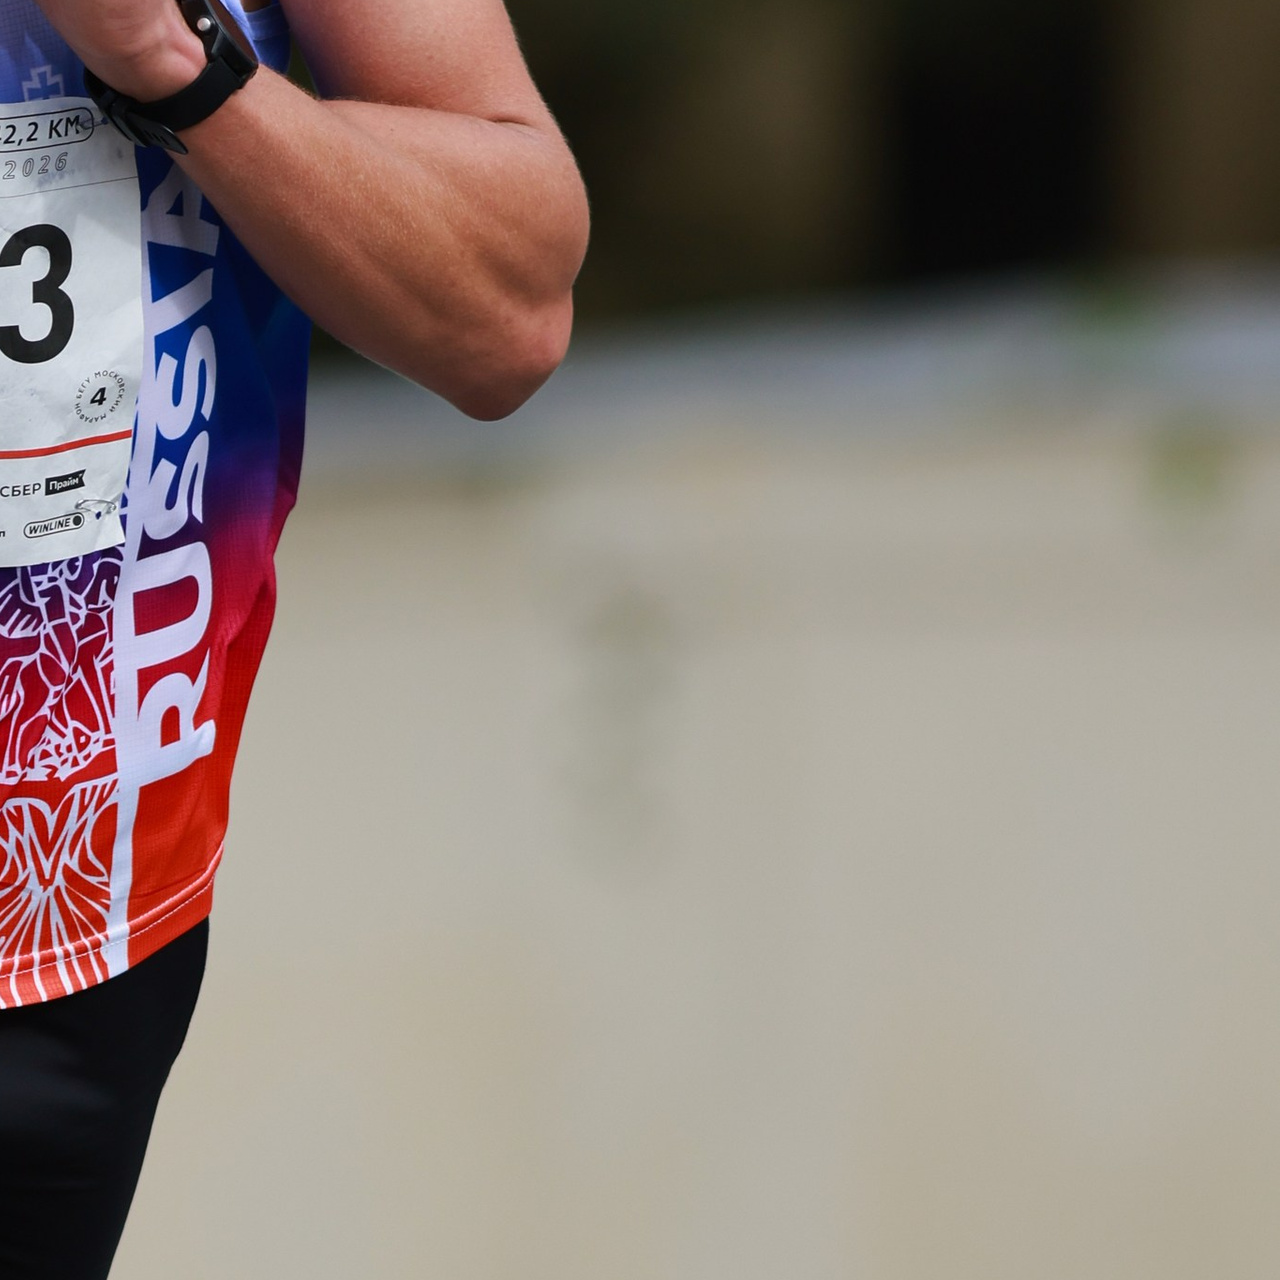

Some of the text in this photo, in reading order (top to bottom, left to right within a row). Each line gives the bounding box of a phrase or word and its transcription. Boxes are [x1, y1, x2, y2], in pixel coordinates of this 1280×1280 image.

[2, 152, 68, 180] 2026
[89, 386, 107, 406] 4
[0, 483, 42, 498] СБЕР
[28, 517, 71, 536] WINLINE
